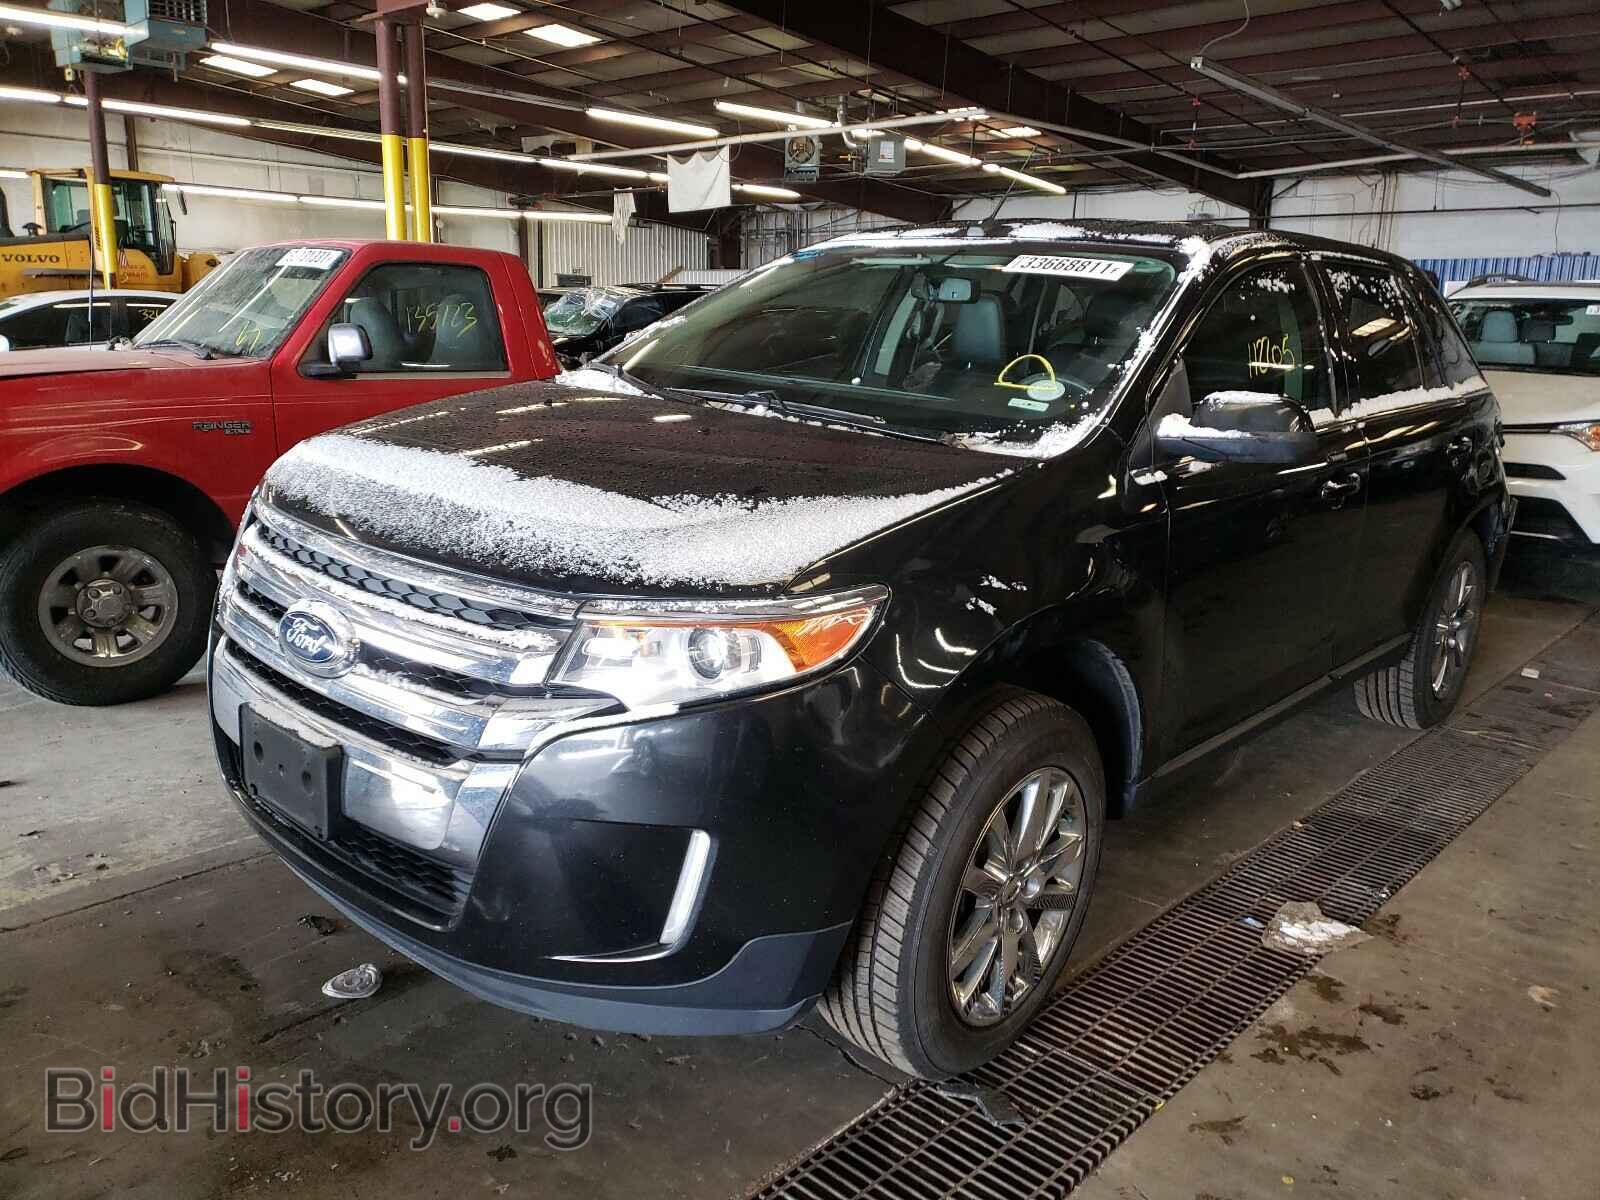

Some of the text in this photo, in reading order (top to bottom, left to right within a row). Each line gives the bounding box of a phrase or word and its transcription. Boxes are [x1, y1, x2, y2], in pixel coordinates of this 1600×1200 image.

[2, 254, 60, 263] VOLVO
[192, 421, 252, 432] RANGER
[286, 618, 335, 655] Ford
